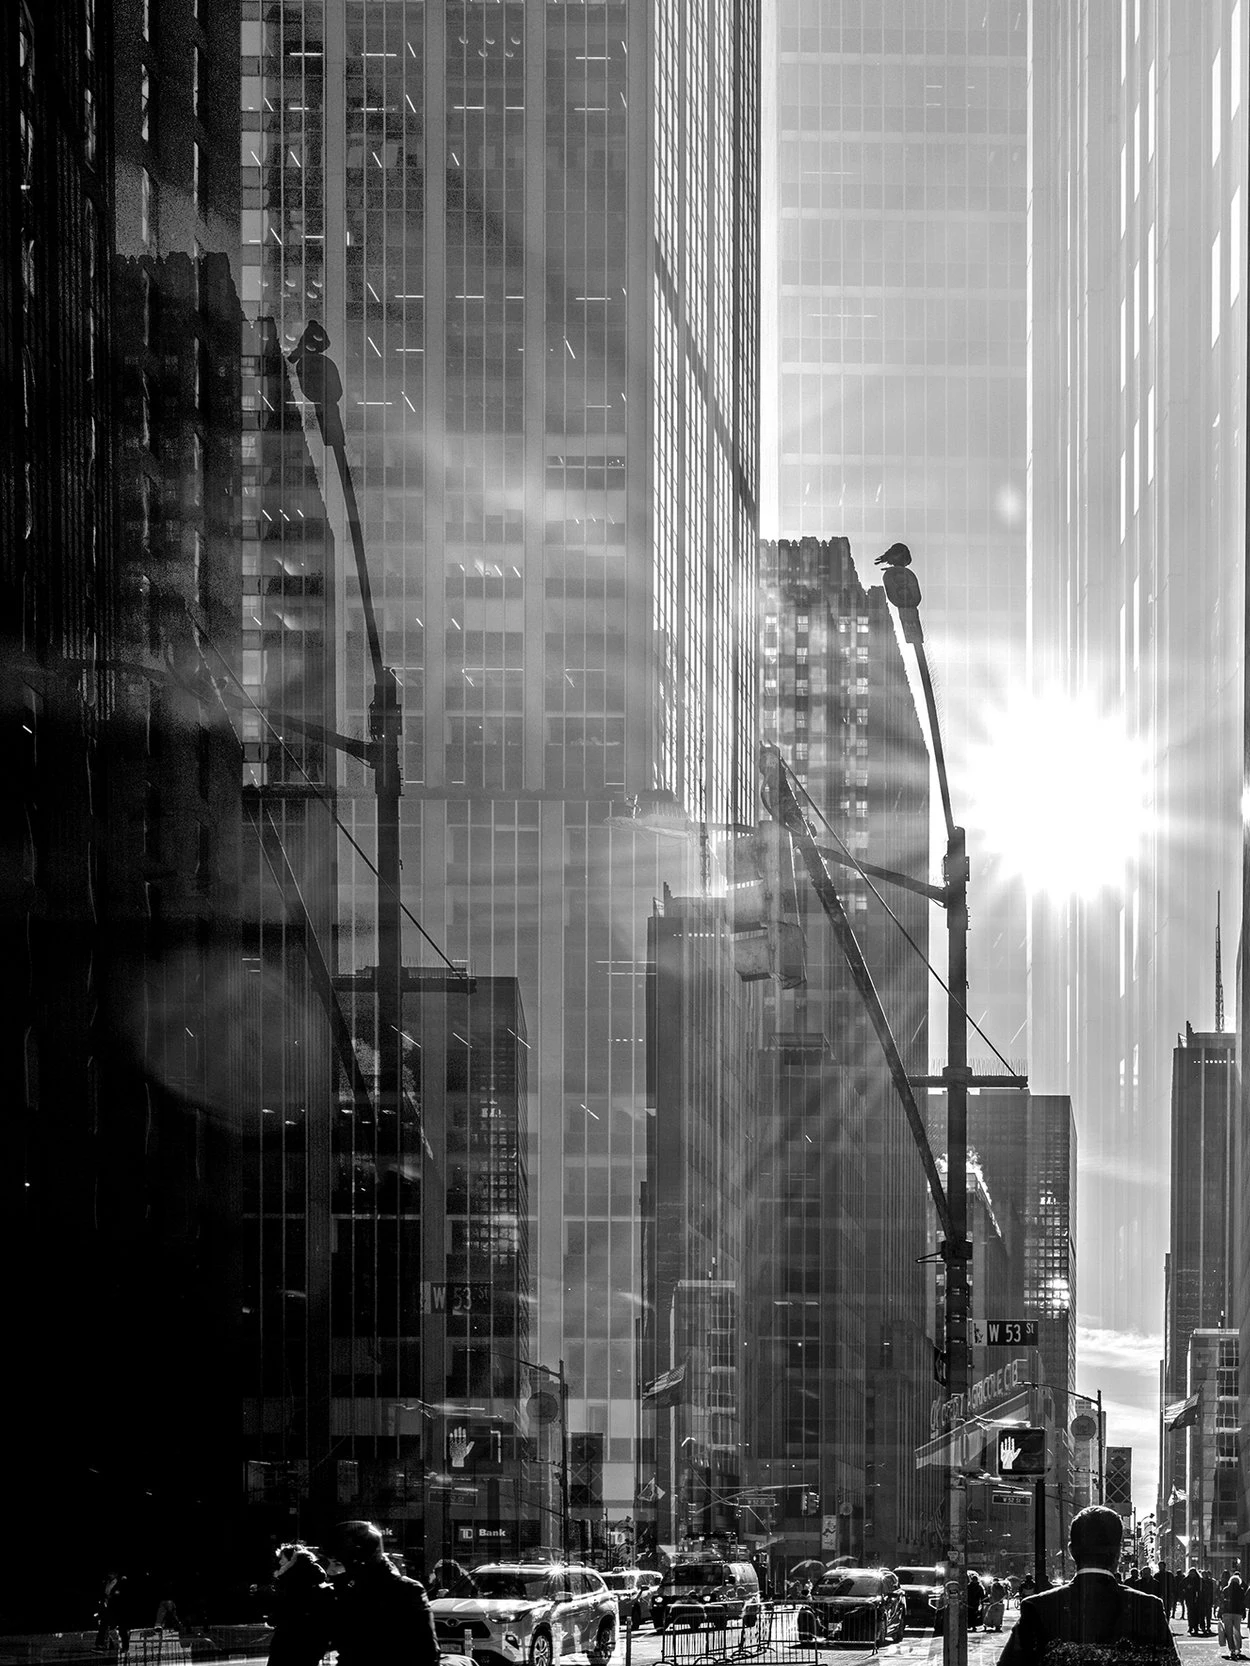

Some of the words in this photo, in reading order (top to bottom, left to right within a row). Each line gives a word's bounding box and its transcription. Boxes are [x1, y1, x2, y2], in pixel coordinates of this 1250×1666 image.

[433, 1286, 447, 1310] W
[453, 1286, 472, 1310] 53
[988, 1324, 1000, 1343] W
[1005, 1323, 1021, 1343] 53
[1026, 1322, 1035, 1334] St
[380, 1527, 394, 1536] nk
[459, 1528, 474, 1539] TD
[478, 1528, 507, 1537] Bank
